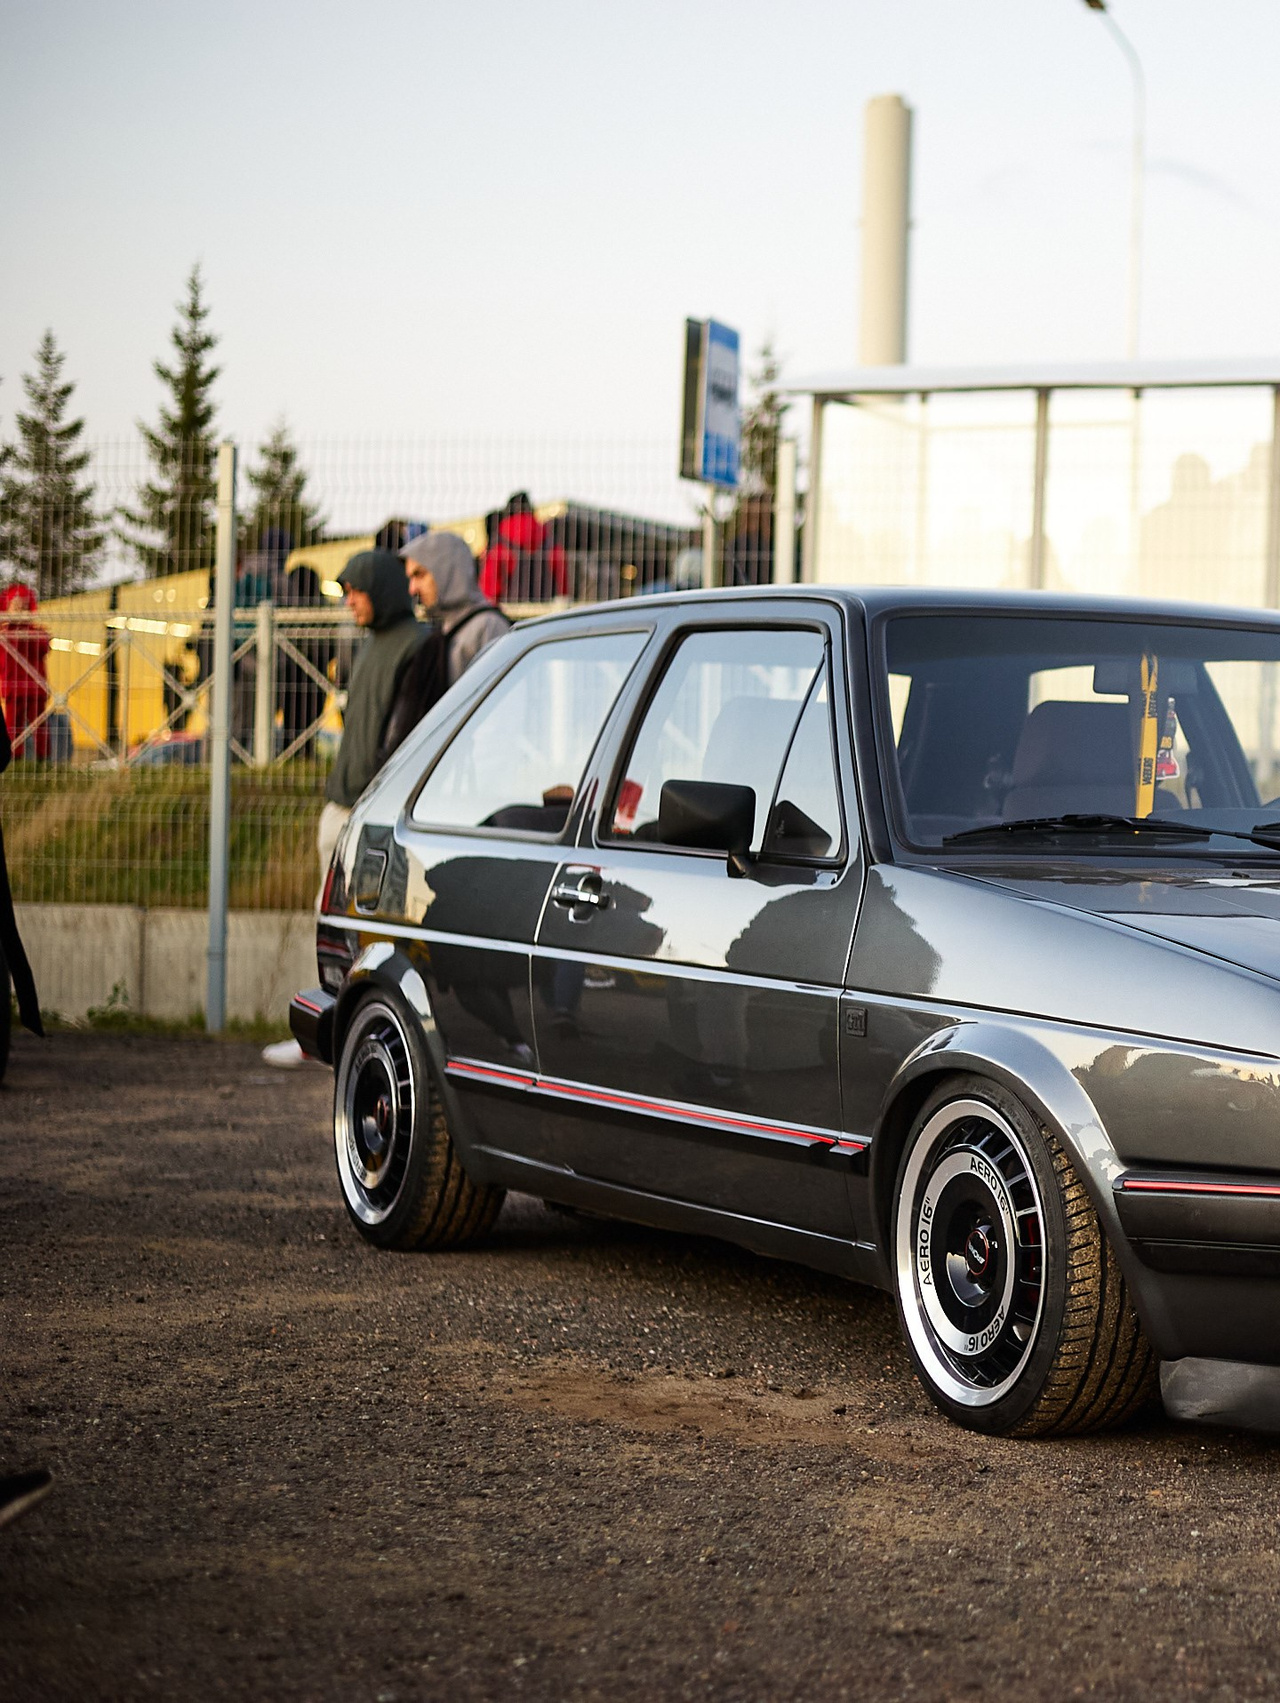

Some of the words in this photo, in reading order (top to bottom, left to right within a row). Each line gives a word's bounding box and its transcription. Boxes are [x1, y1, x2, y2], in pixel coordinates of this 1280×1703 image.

[970, 1156, 998, 1188] AERO
[918, 1230, 933, 1286] AERO
[980, 1305, 1006, 1346] AERO
